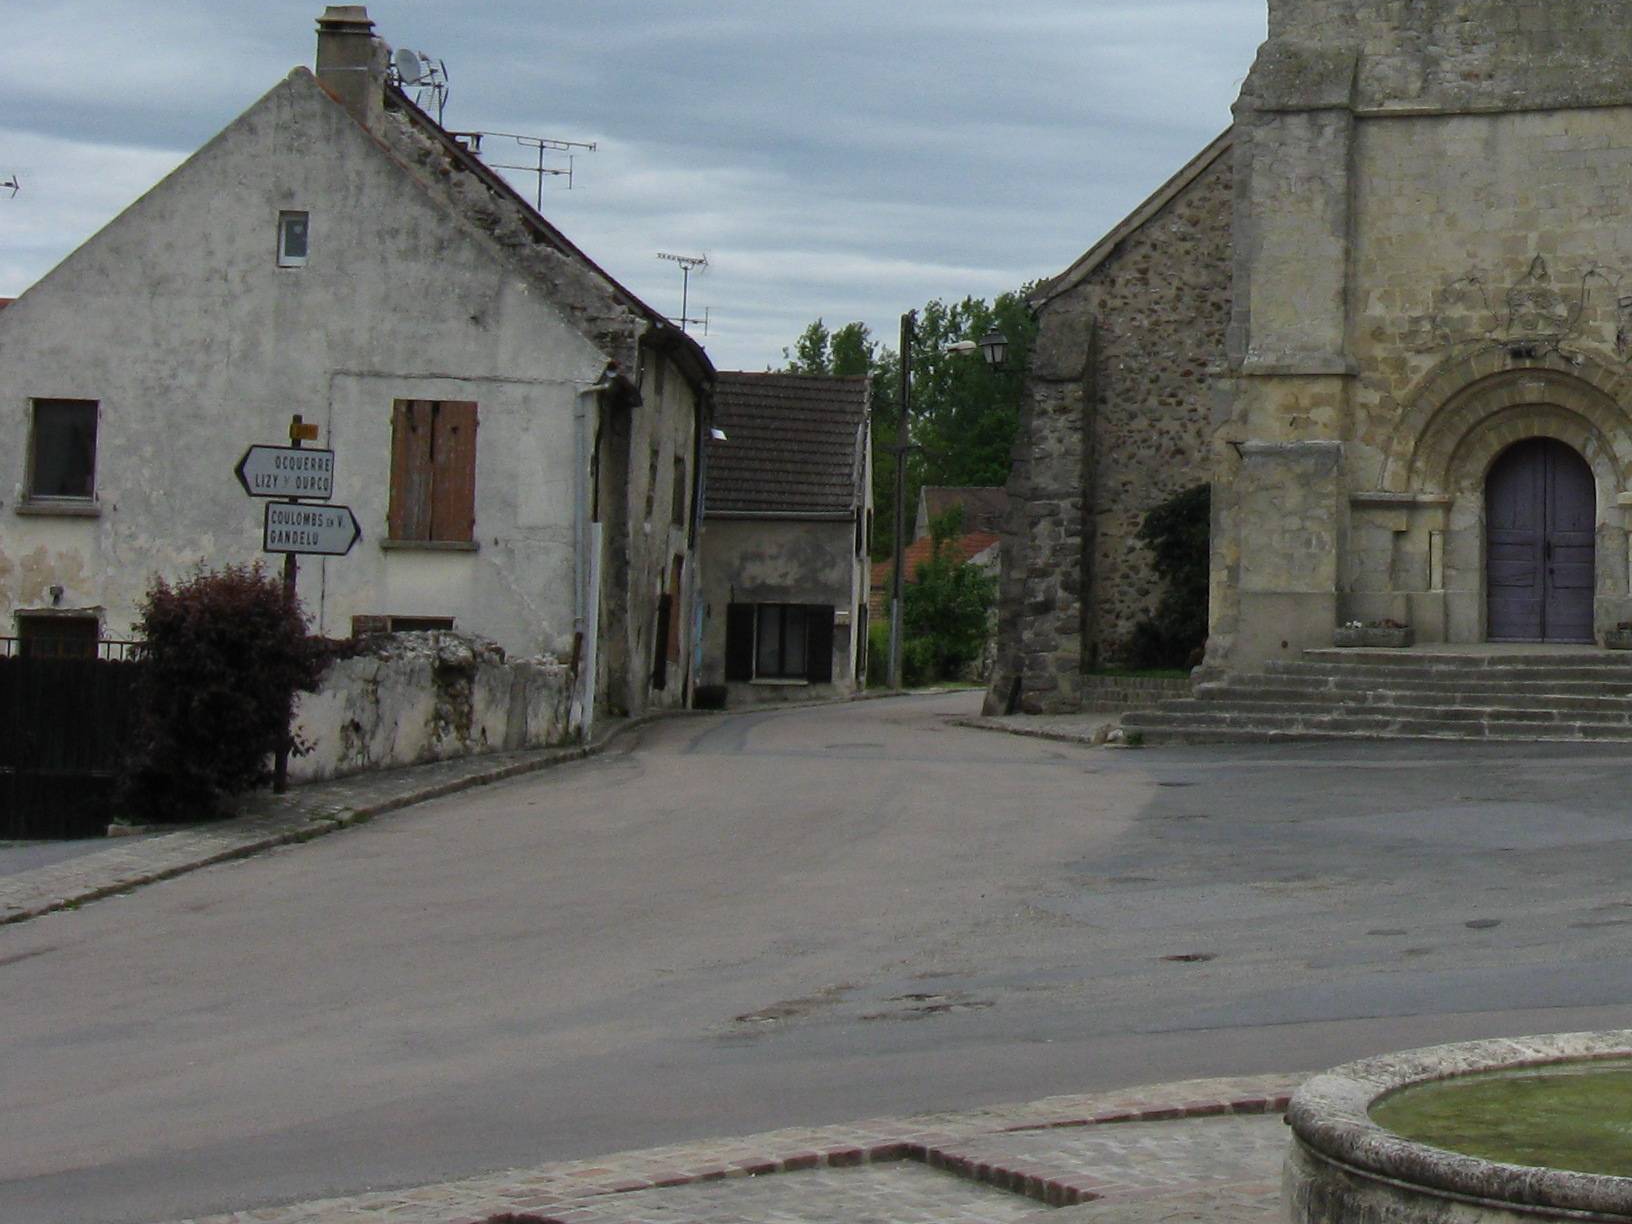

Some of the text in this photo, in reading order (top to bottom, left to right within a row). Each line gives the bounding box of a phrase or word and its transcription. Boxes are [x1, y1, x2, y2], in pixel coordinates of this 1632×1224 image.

[275, 455, 331, 472] OCQUERRE
[255, 473, 278, 488] LIZY
[271, 510, 323, 527] COULOMBS
[270, 530, 319, 546] GANDELU
